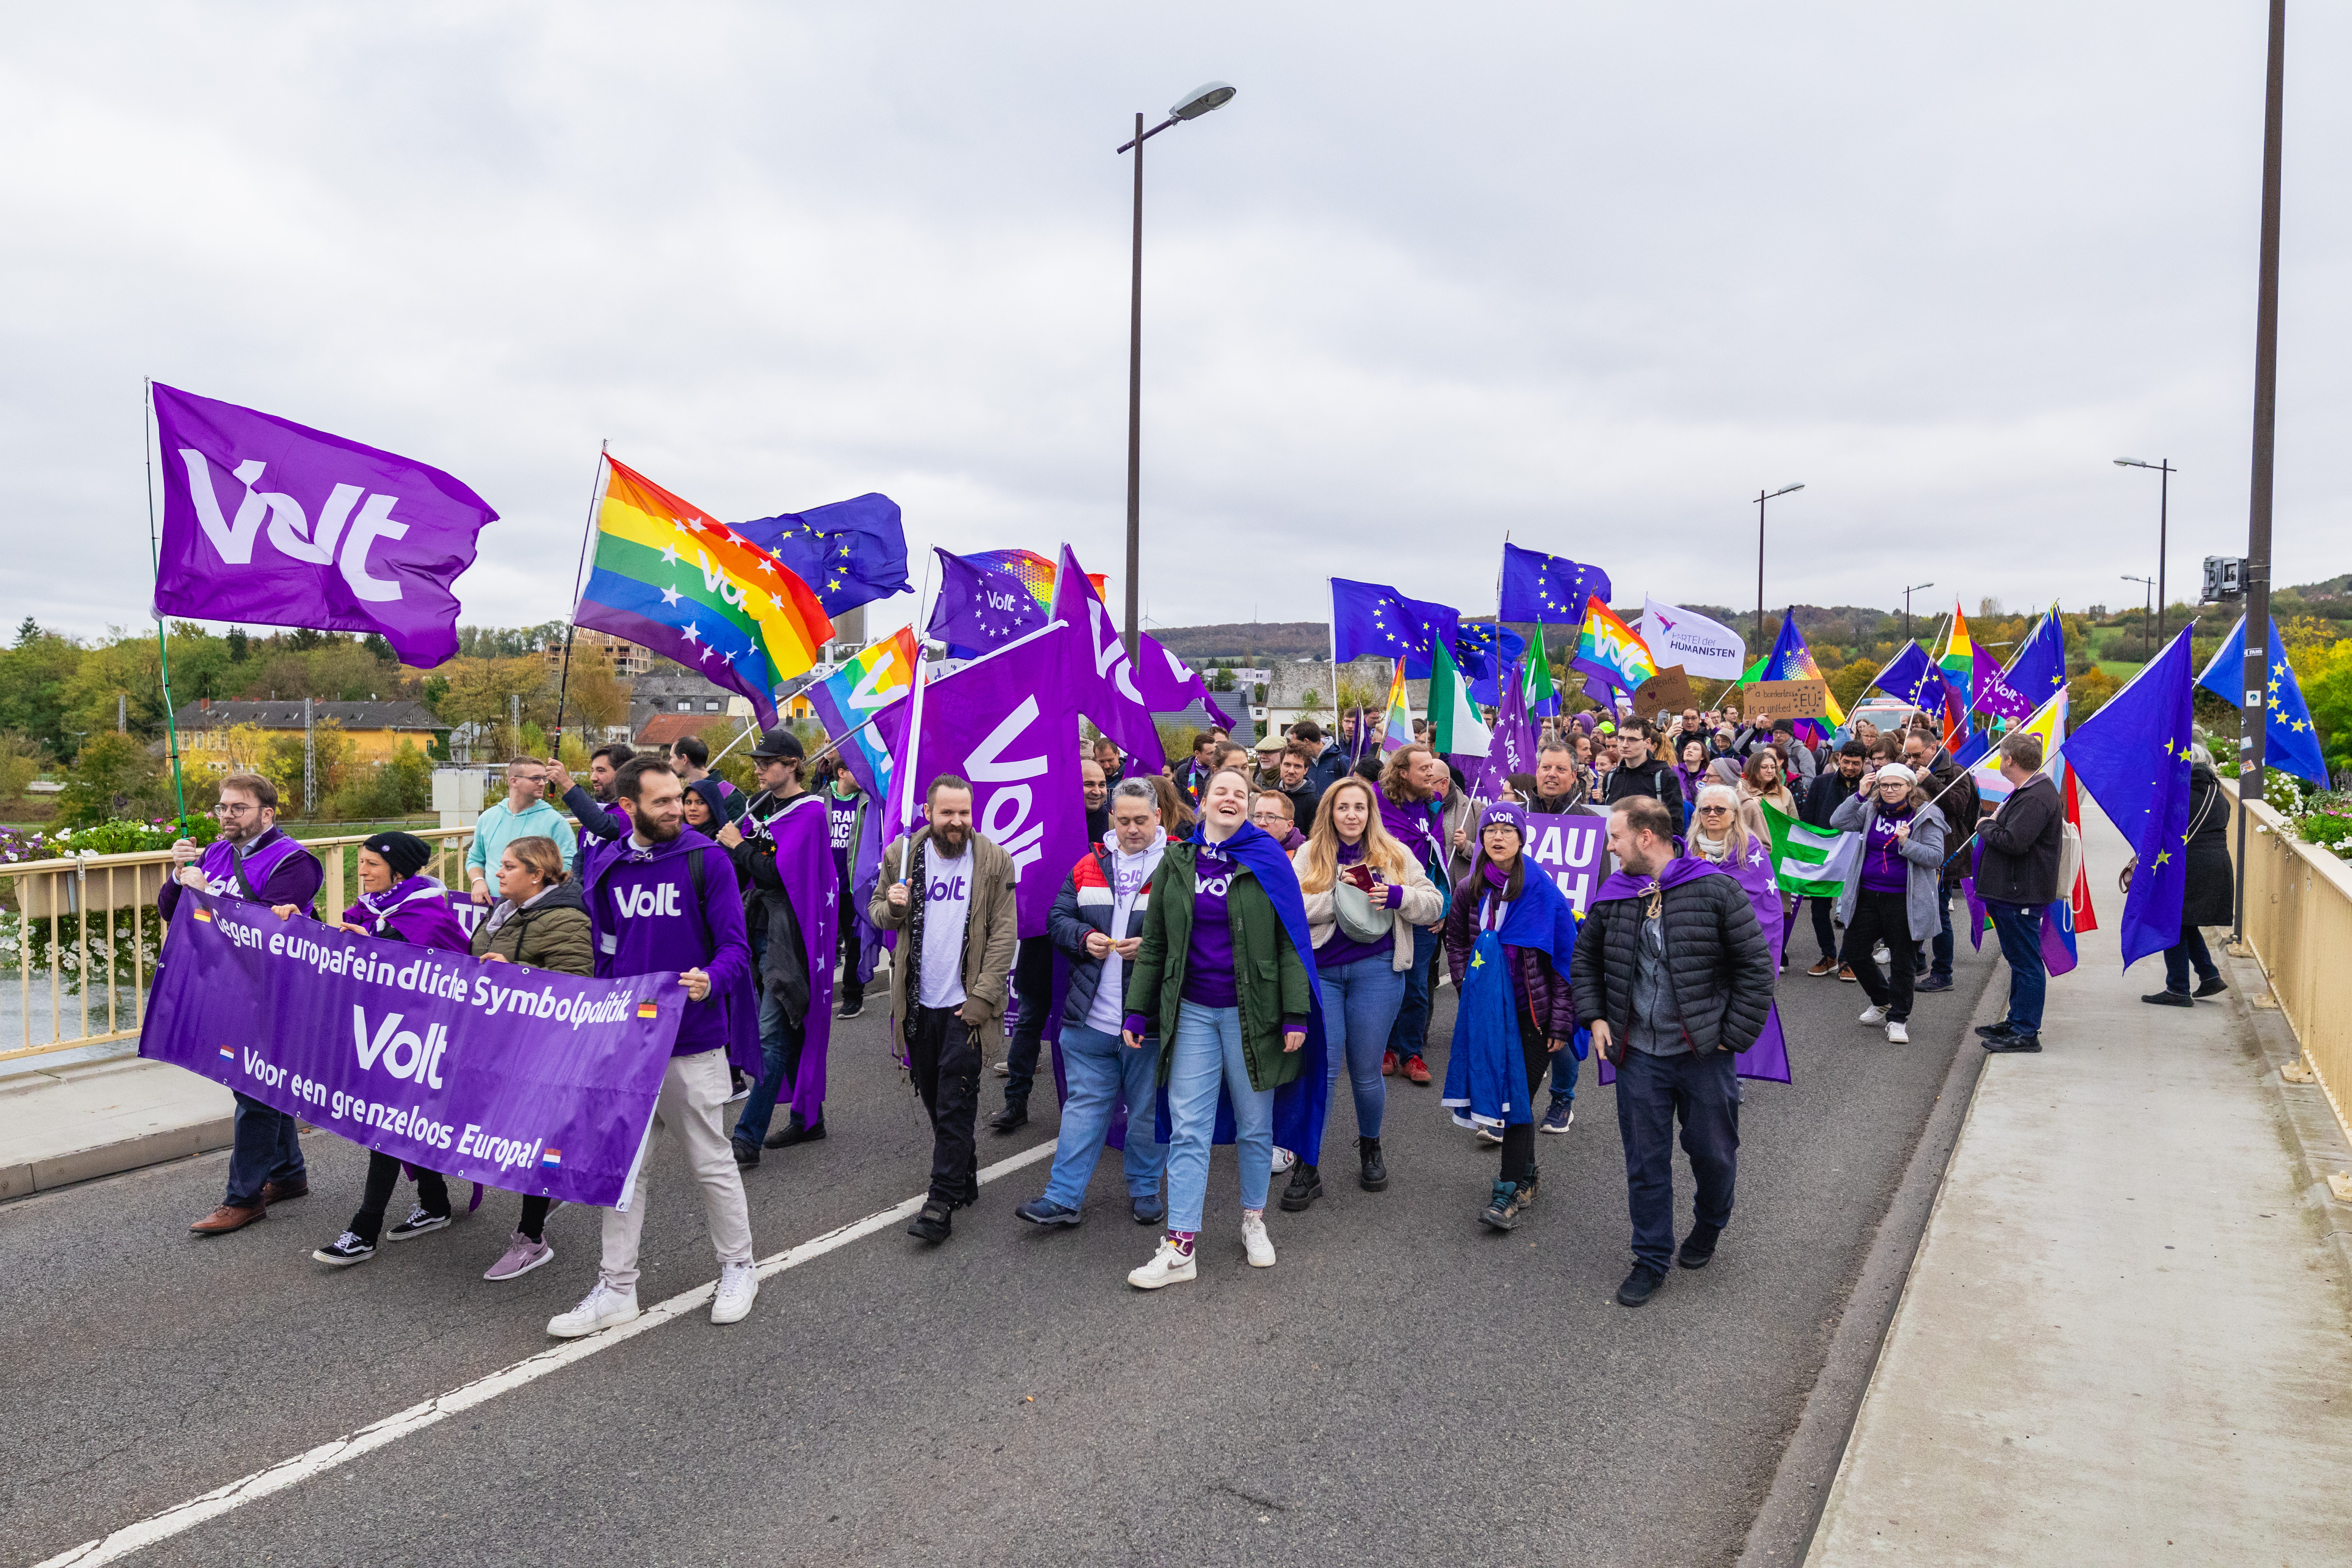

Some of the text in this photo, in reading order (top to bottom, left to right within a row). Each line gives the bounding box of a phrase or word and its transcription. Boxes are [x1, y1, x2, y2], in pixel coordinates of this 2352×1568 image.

[178, 449, 410, 602] Volt
[986, 590, 1016, 612] Volt
[1592, 614, 1649, 682] Volt
[1670, 640, 1735, 657] HUMANISTEN
[1672, 632, 1717, 646] PARTEI der
[1635, 675, 1678, 696] pen Hearts
[1763, 689, 1795, 698] borderless
[1994, 680, 2018, 702] Volt
[1637, 702, 1657, 715] Open
[1800, 693, 1817, 707] EU
[1504, 729, 1521, 773] Volt
[1489, 811, 1514, 824] Volt
[925, 875, 965, 902] Volt
[613, 883, 682, 918] Volt
[212, 908, 262, 950] Gegen
[269, 933, 468, 1002] europafeindliche
[354, 1004, 448, 1089] Volt
[244, 1046, 543, 1172] Voor een grenzeloos Europa!
